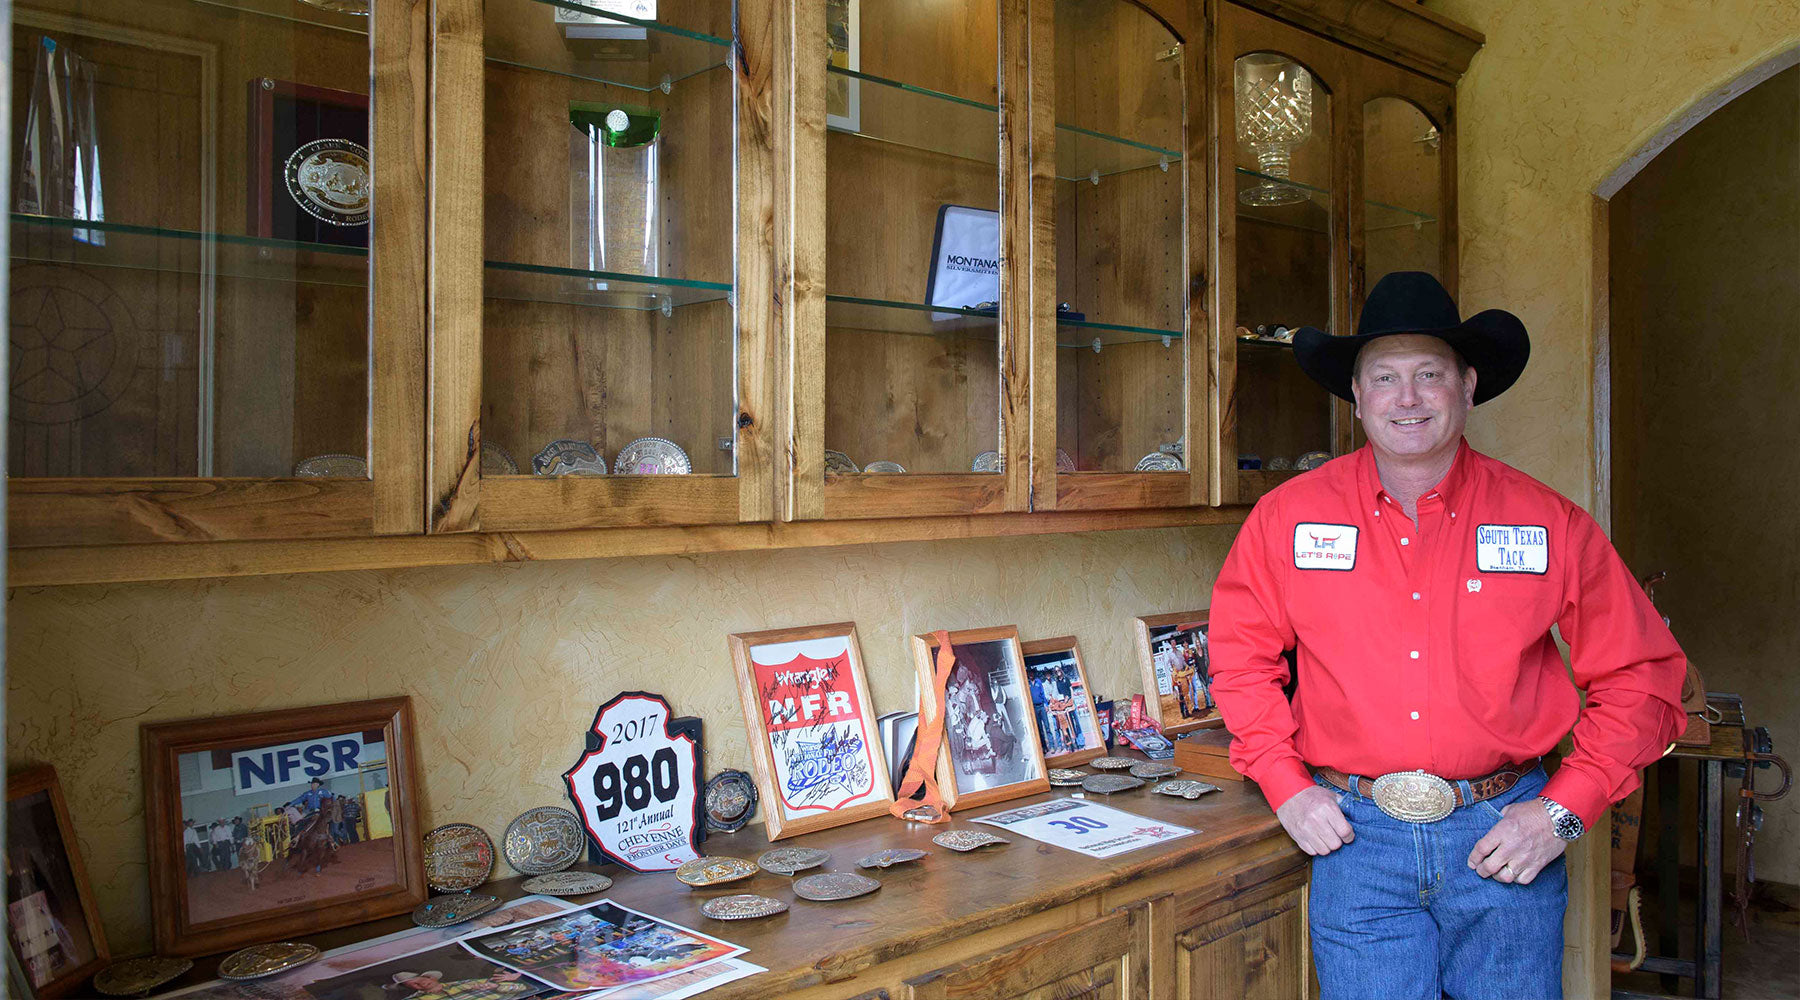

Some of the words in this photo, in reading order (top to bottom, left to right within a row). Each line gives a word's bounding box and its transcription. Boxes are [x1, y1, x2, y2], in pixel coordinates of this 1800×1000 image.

[946, 254, 999, 269] MONTANA
[1295, 551, 1323, 559] LET'S
[768, 690, 853, 725] NFR
[611, 714, 659, 746] 2017
[238, 738, 361, 790] NFSR
[791, 752, 857, 781] RODEO
[592, 746, 680, 822] 980
[638, 804, 674, 830] Annual
[1047, 815, 1109, 835] 30
[617, 825, 684, 852] CHEYENNE
[626, 844, 667, 862] FRONTIER
[665, 837, 688, 852] DAYS
